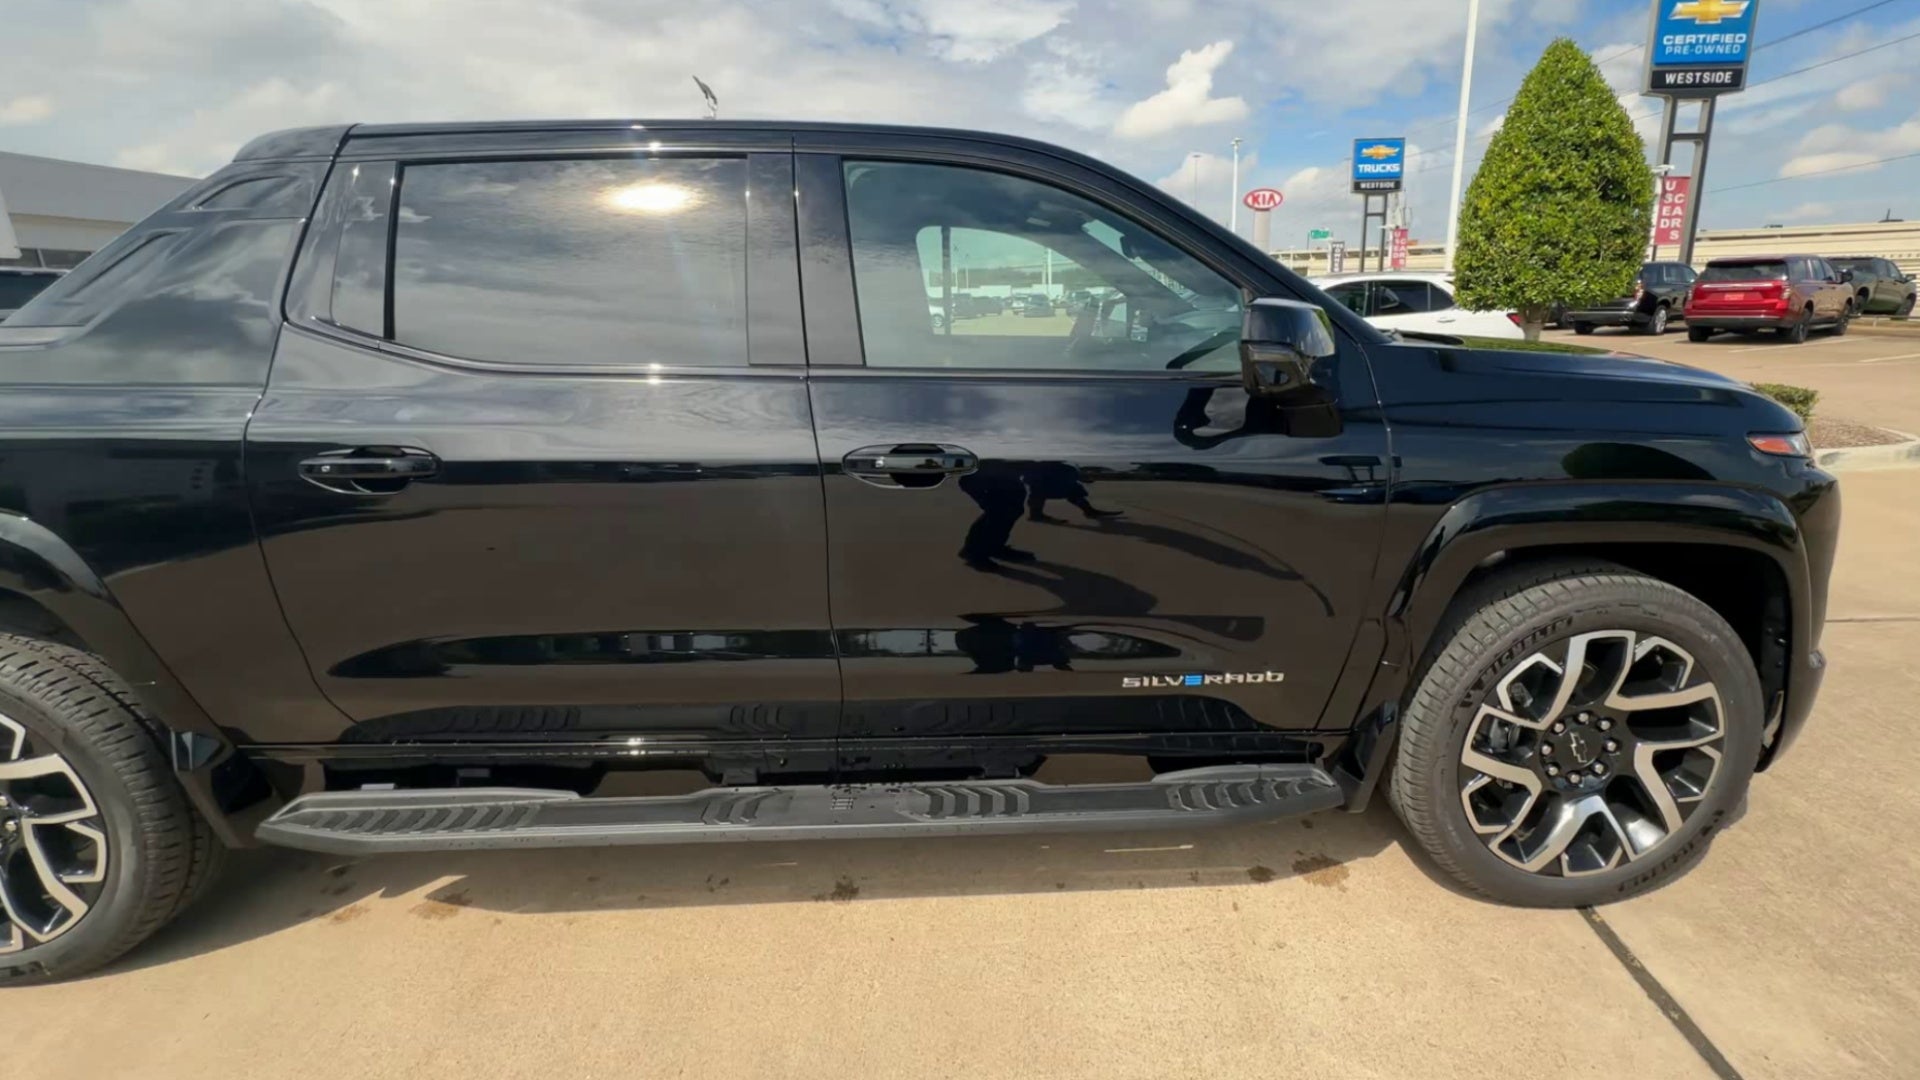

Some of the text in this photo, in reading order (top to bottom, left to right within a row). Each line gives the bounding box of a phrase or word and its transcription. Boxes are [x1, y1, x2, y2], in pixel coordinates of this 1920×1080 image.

[1662, 32, 1748, 46] CERTIFIED
[1664, 44, 1742, 55] PRE-OWNED
[1665, 71, 1734, 84] WESTSIDE
[1357, 163, 1400, 173] TRUCKS
[1360, 181, 1396, 189] WESTSIDE
[1251, 192, 1277, 206] KIA
[1659, 180, 1677, 229] USED
[1669, 193, 1686, 240] CARS
[1122, 671, 1285, 688] SILVERADO
